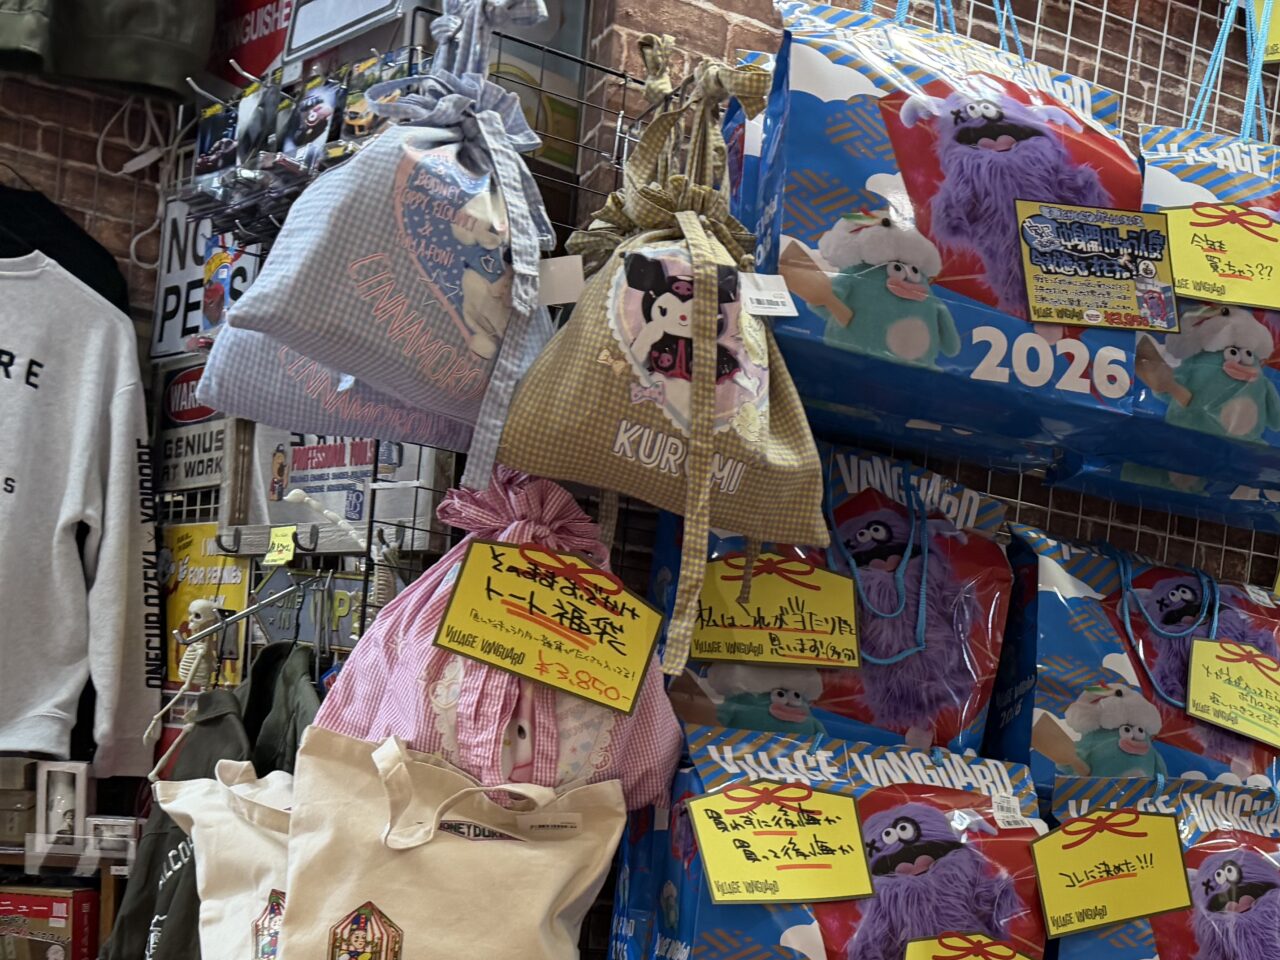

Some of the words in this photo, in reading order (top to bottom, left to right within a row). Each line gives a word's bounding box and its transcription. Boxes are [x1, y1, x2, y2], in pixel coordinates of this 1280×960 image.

[971, 325, 1132, 400] 2026
[164, 429, 225, 456] GENIUS
[184, 457, 223, 480] WORK
[444, 624, 488, 651] VILLAGE
[479, 635, 526, 666] VANGUARD
[707, 744, 848, 786] VILLAGE
[849, 751, 1013, 798] VANGUARD
[1050, 910, 1076, 930] VILLAGE
[1076, 904, 1108, 924] VANGUARD
